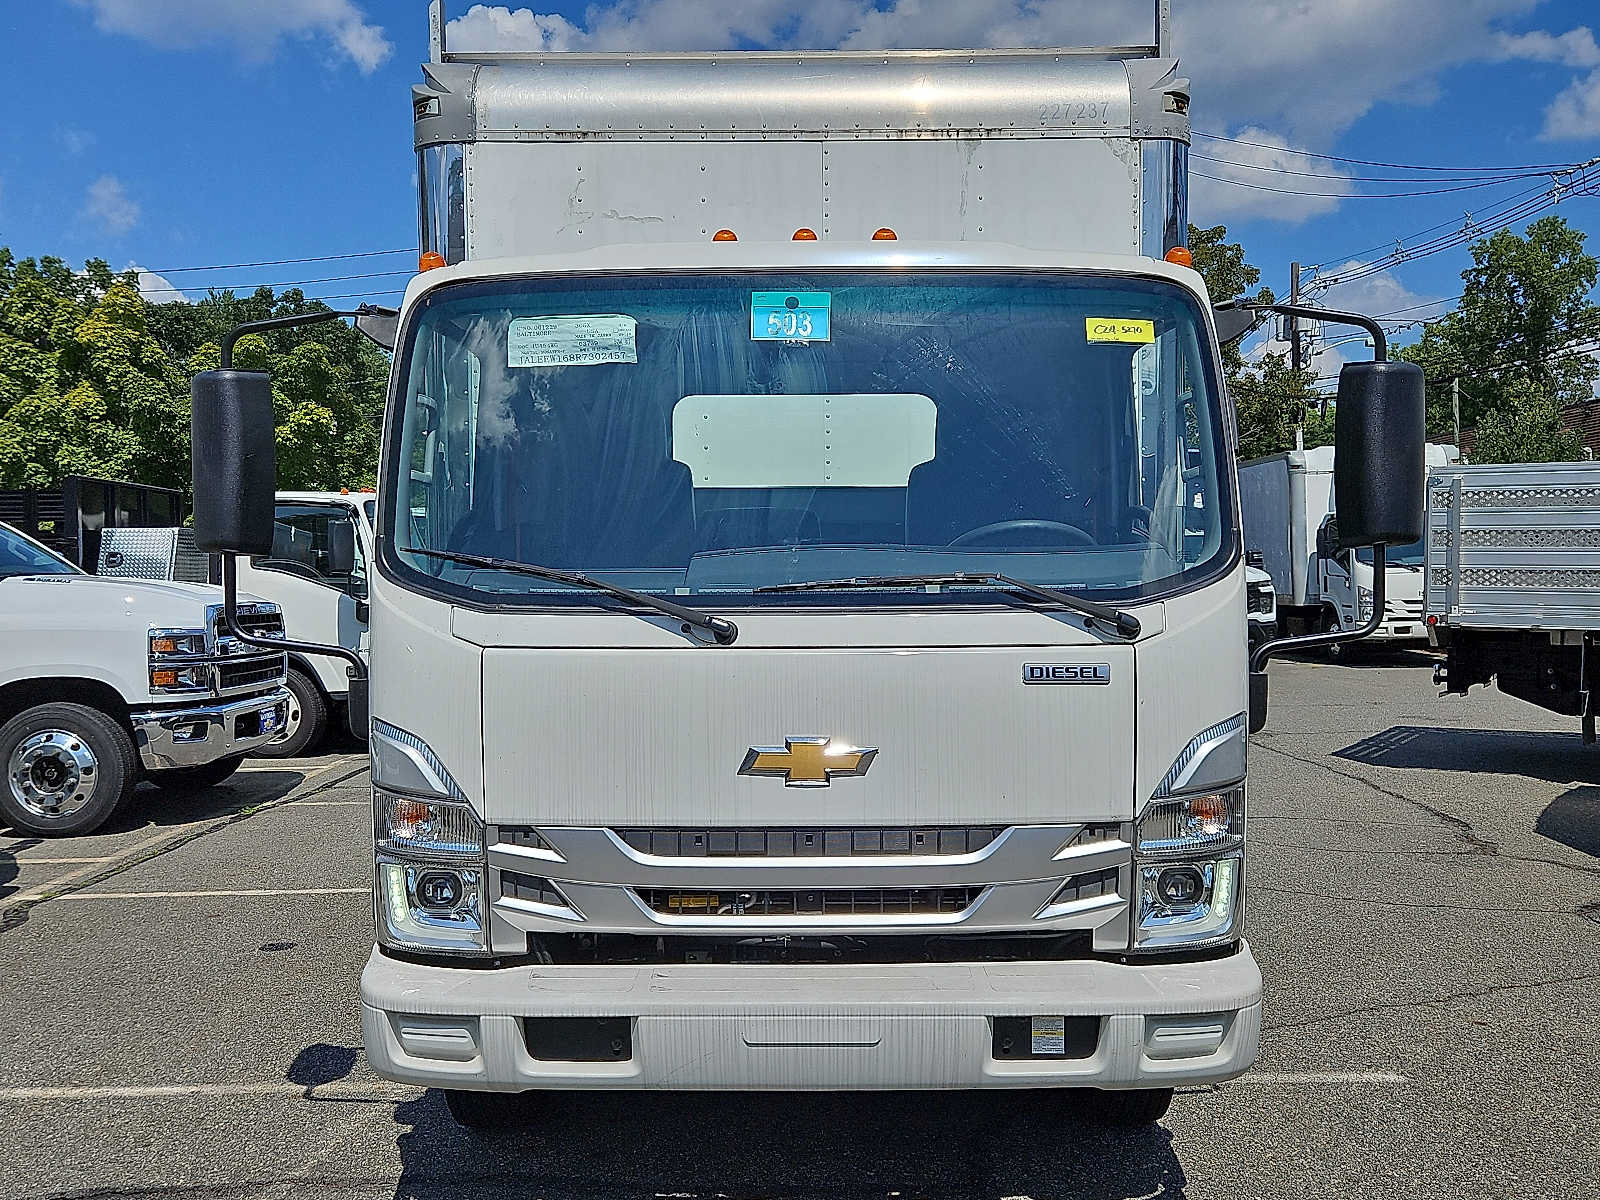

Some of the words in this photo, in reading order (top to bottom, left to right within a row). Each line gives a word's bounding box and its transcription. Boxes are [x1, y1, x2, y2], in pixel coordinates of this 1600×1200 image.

[1039, 103, 1109, 120] 227237
[767, 310, 814, 337] 503
[1029, 666, 1105, 679] DIESEL
